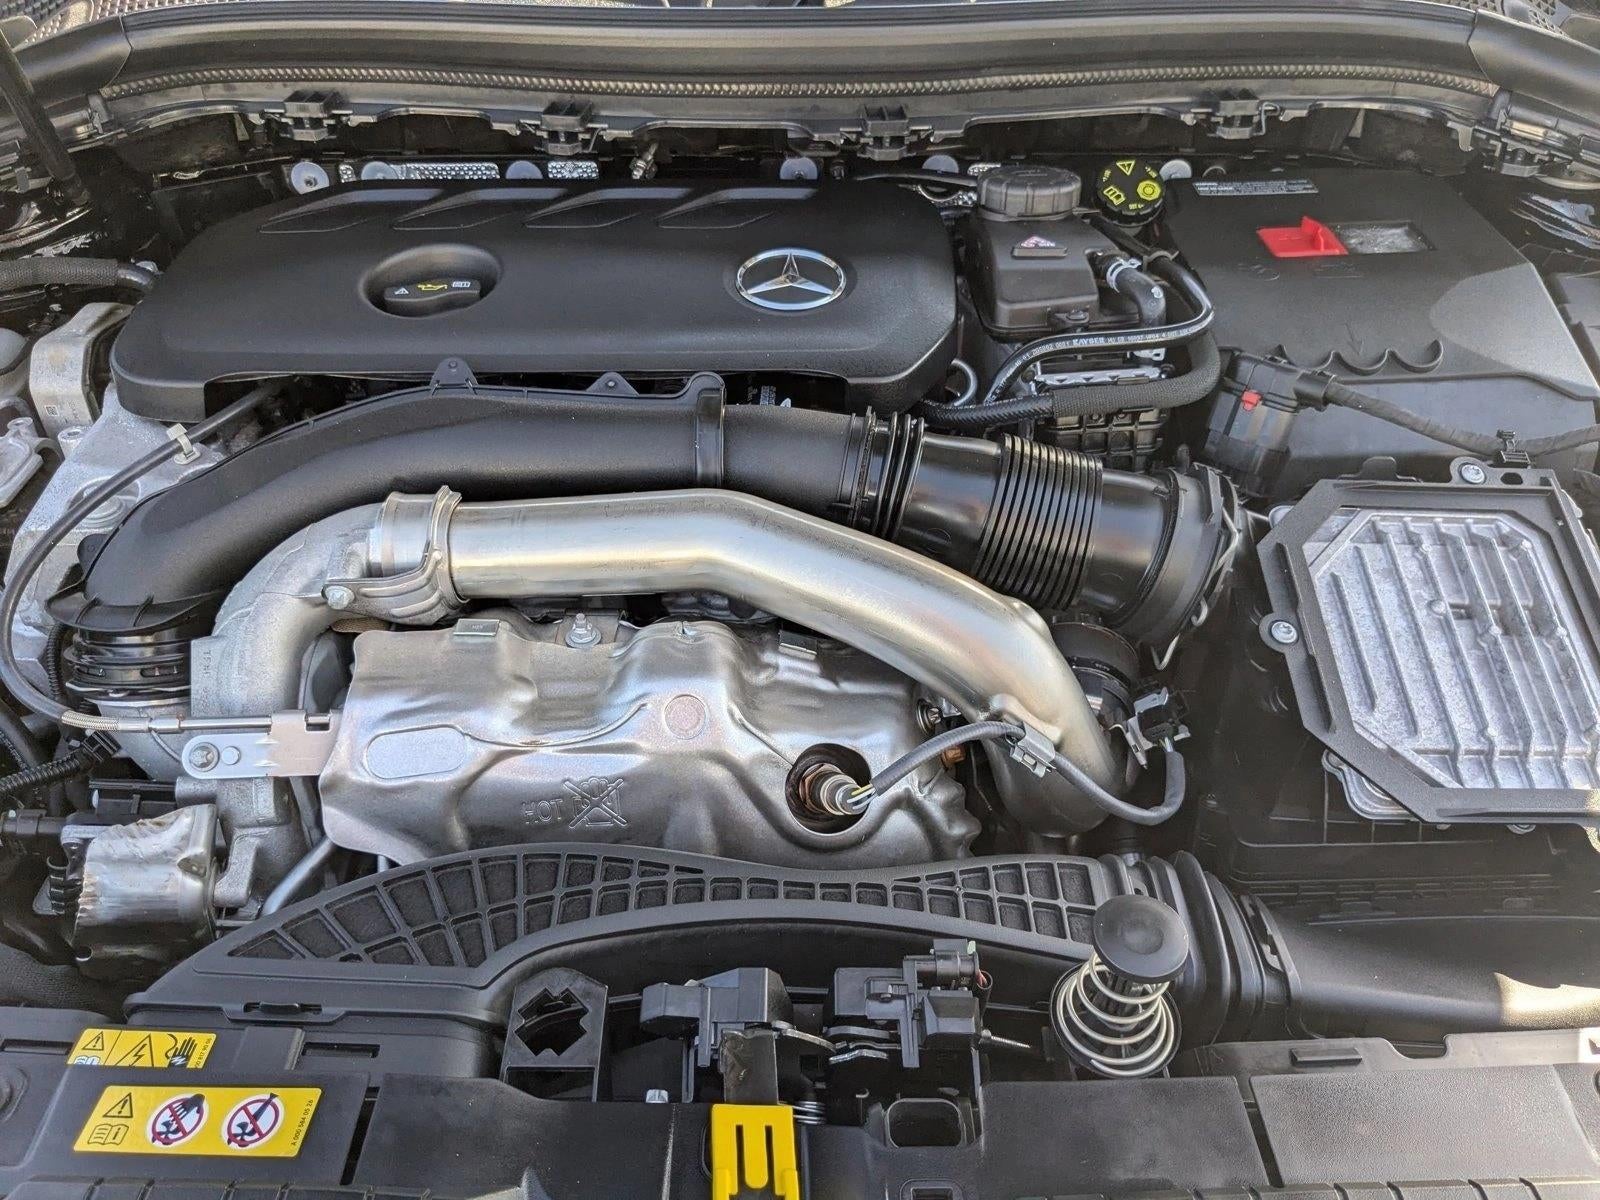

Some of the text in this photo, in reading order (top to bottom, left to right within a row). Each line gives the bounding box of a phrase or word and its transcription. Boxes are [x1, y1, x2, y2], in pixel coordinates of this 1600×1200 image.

[521, 798, 563, 824] HOT
[306, 1099, 314, 1107] 26
[303, 1107, 310, 1116] 05
